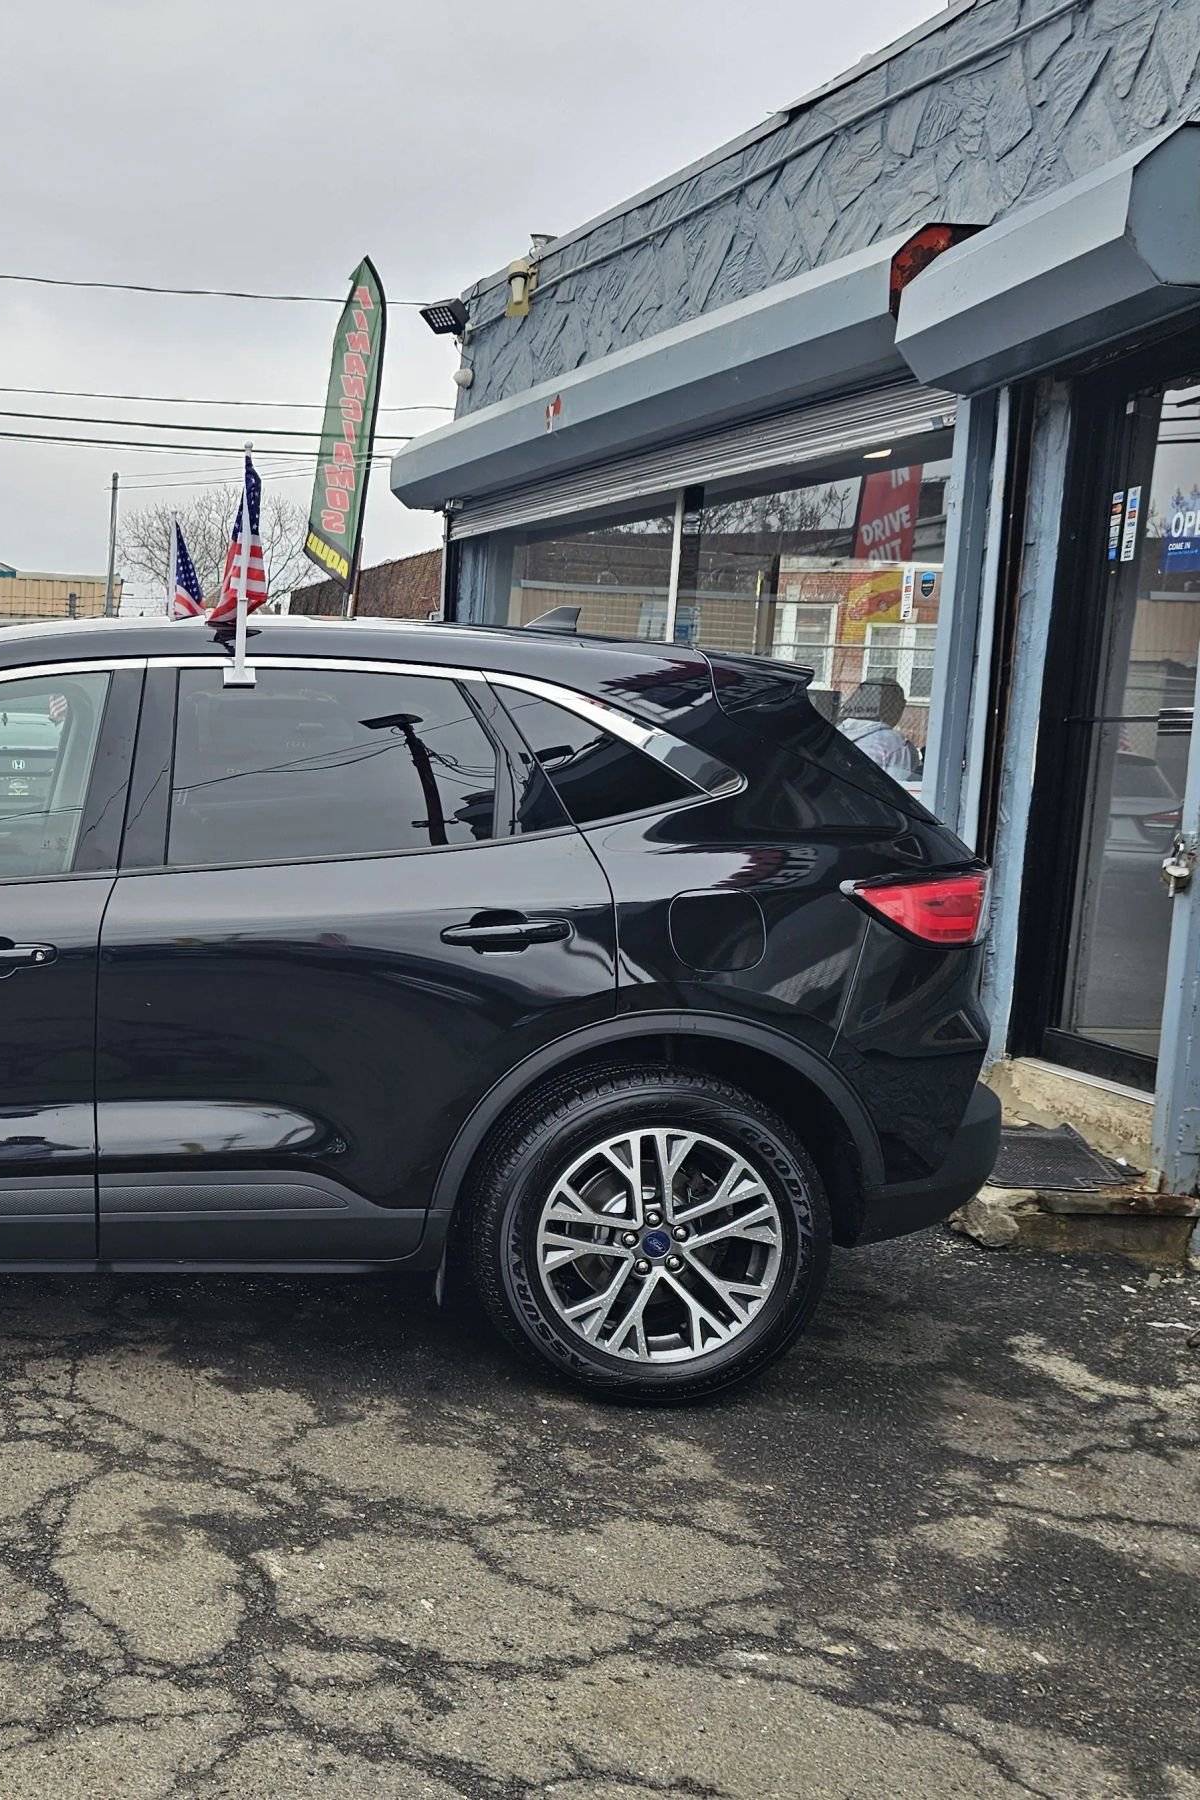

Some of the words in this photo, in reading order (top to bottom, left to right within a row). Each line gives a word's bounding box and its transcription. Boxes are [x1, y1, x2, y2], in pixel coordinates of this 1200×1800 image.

[891, 467, 910, 489] IN
[861, 505, 912, 546] DRIVE
[1168, 543, 1184, 551] COME
